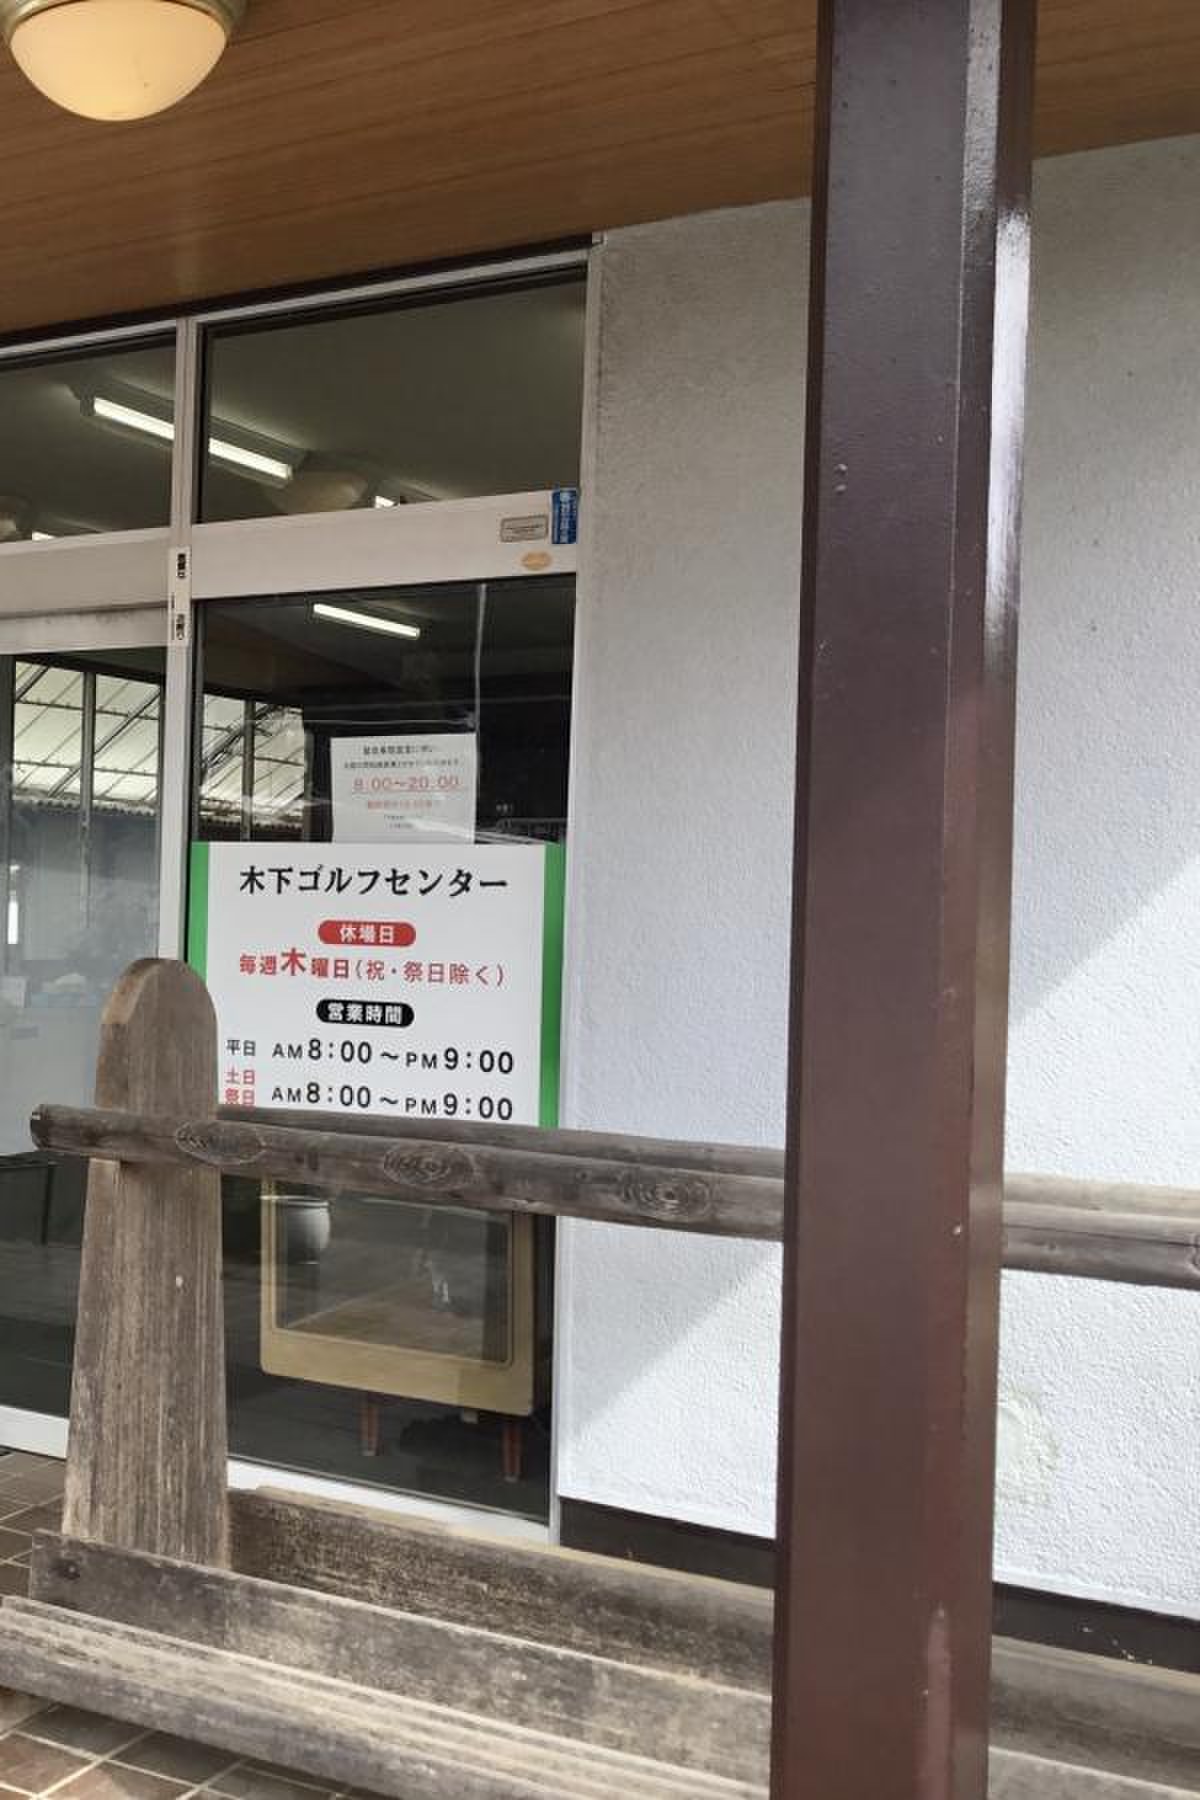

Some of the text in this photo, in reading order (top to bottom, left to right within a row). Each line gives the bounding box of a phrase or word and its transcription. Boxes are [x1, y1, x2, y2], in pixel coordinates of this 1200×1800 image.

[239, 864, 508, 897] 木下ゴルフセンター
[339, 923, 395, 944] 休場日
[327, 1002, 403, 1025] 営業時間
[226, 1039, 257, 1057] 平日
[225, 1067, 256, 1086] 土日
